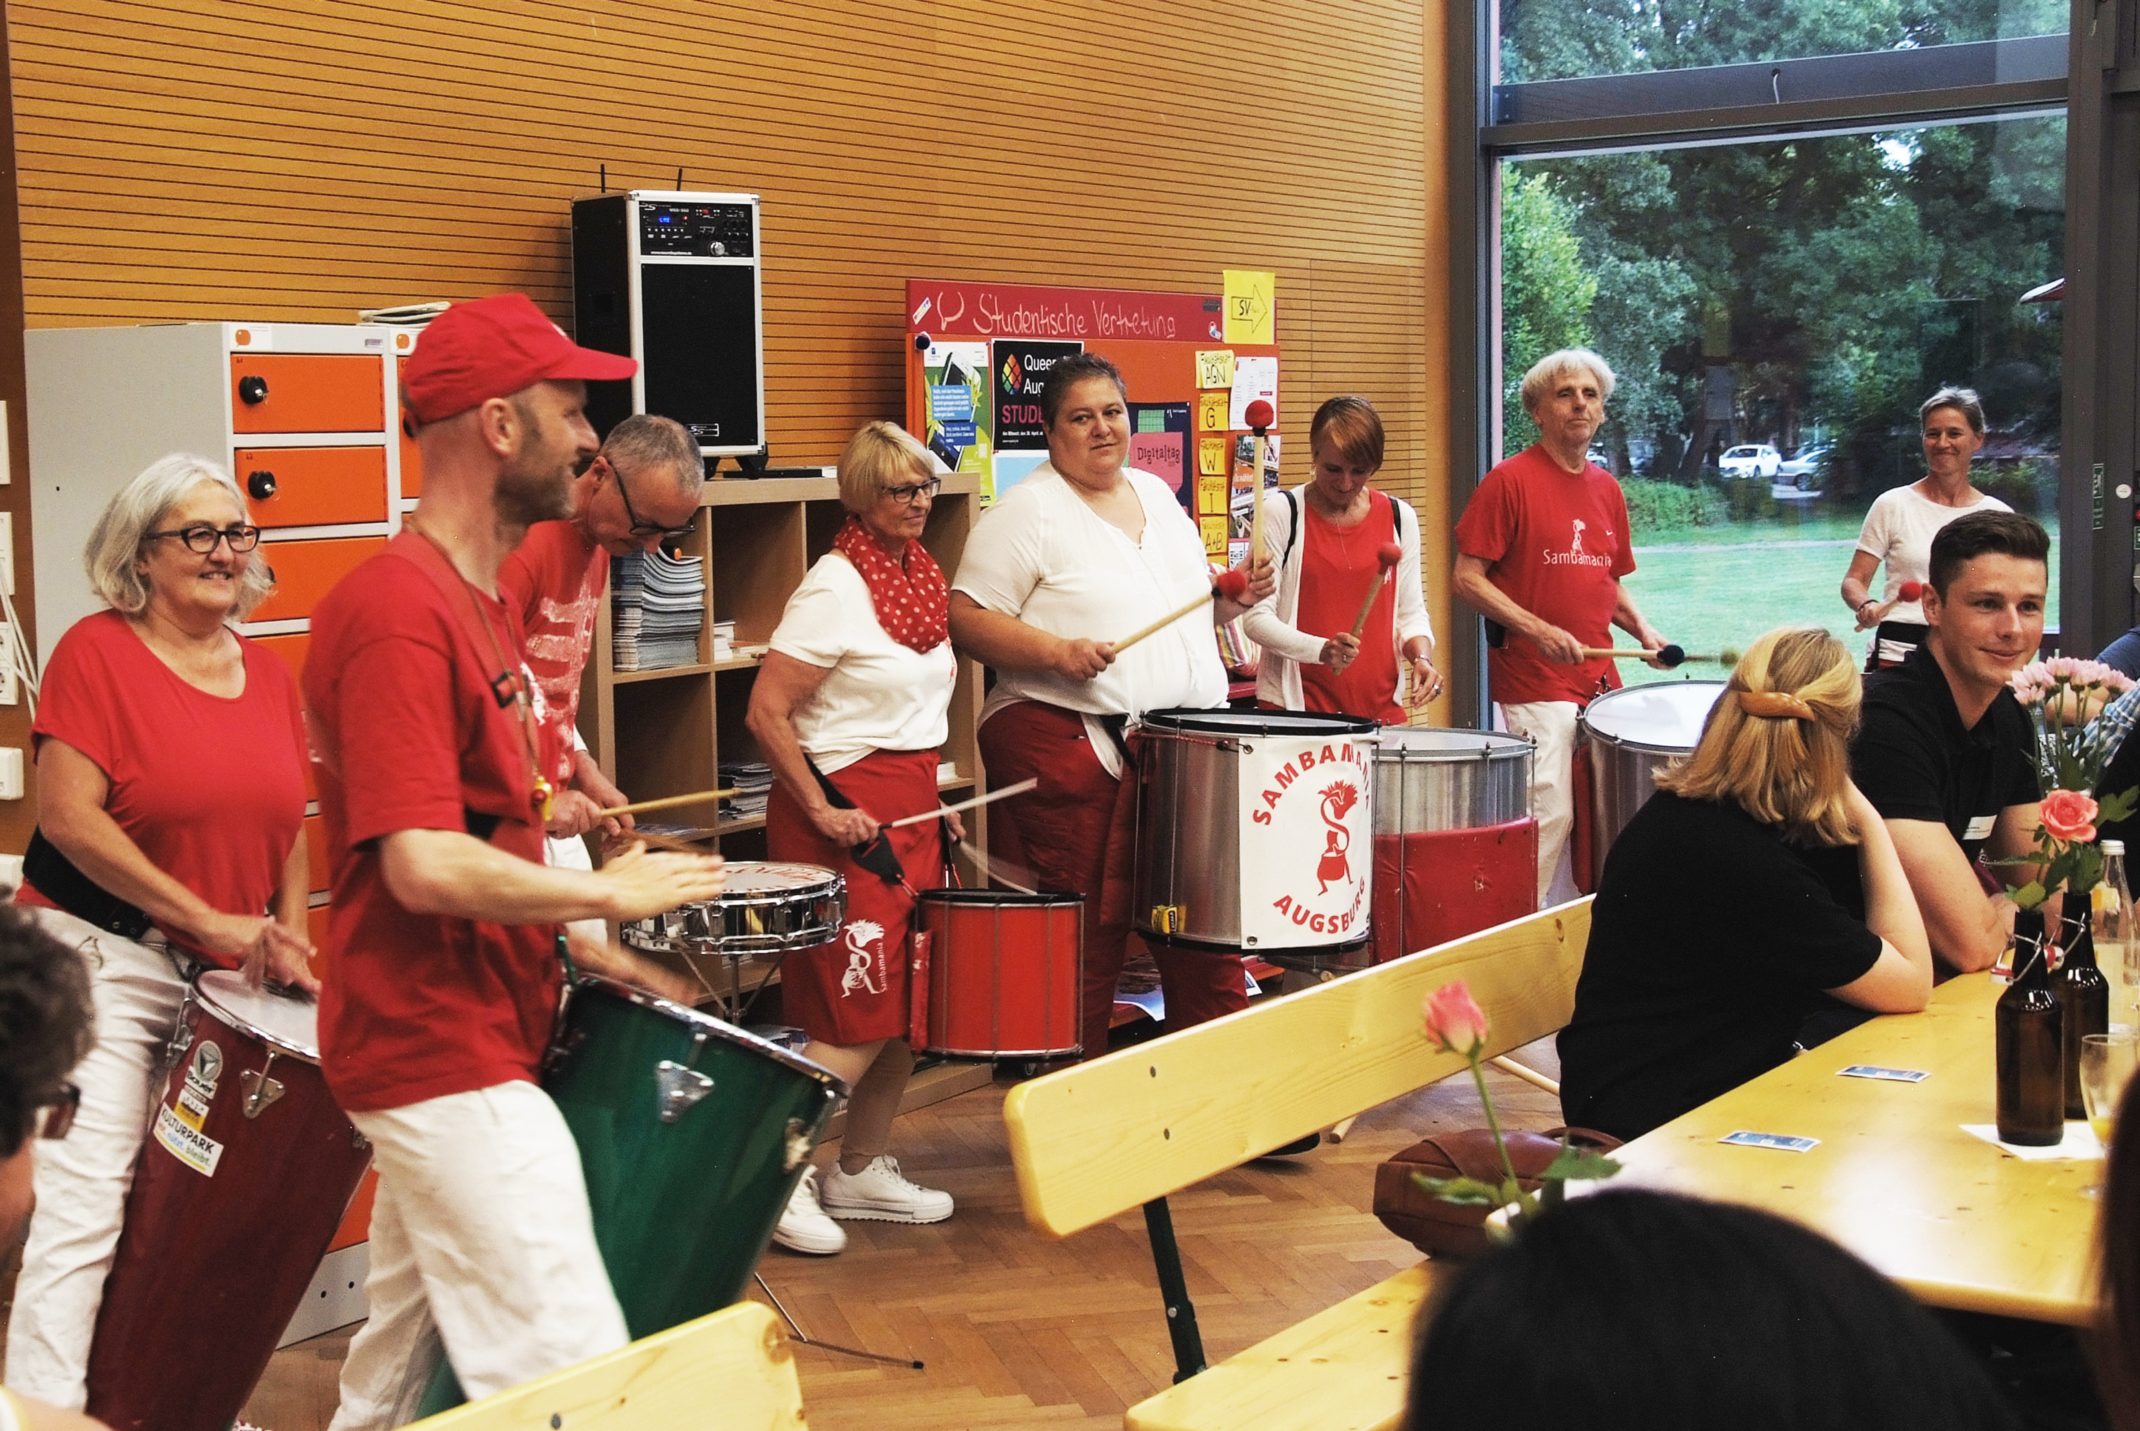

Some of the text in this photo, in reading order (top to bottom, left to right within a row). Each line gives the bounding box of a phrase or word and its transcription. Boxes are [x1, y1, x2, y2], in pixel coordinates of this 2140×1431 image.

[973, 293, 1176, 338] Studentische Vertretung
[1239, 299, 1251, 316] SV
[1023, 353, 1057, 372] Queer
[1205, 363, 1226, 386] AGN
[1206, 406, 1216, 429] G
[1137, 444, 1180, 465] Digitaltag
[1204, 451, 1216, 472] W
[1543, 549, 1612, 568] Sambamania
[1273, 876, 1365, 934] AUGSBURG
[160, 1107, 216, 1155] KULTURPARK
